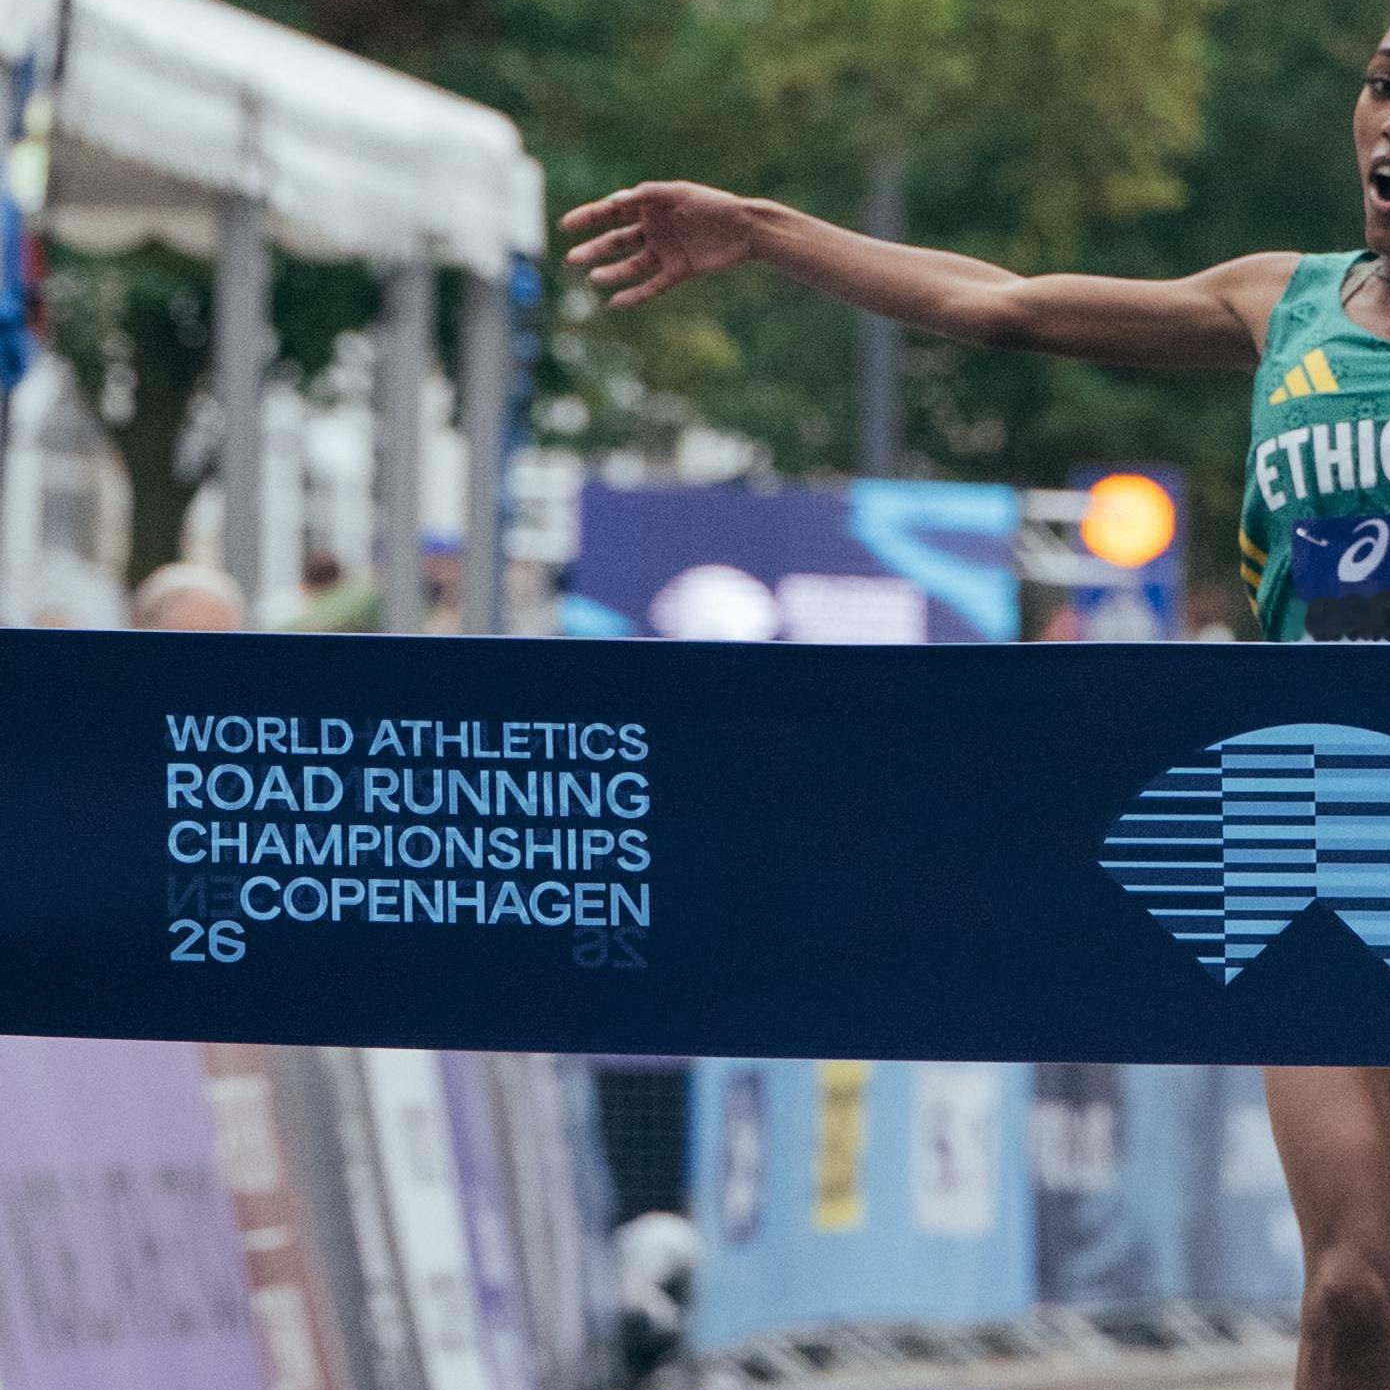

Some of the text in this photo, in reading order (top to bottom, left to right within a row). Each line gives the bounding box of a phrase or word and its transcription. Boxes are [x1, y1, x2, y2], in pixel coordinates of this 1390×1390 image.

[165, 714, 649, 762] WORLD ATHLETICS
[166, 762, 650, 819] ROAD RUNNING
[167, 819, 651, 872] CHAMPIONSHIPS
[239, 875, 650, 927] COPENHAGEN
[168, 918, 246, 963] 26
